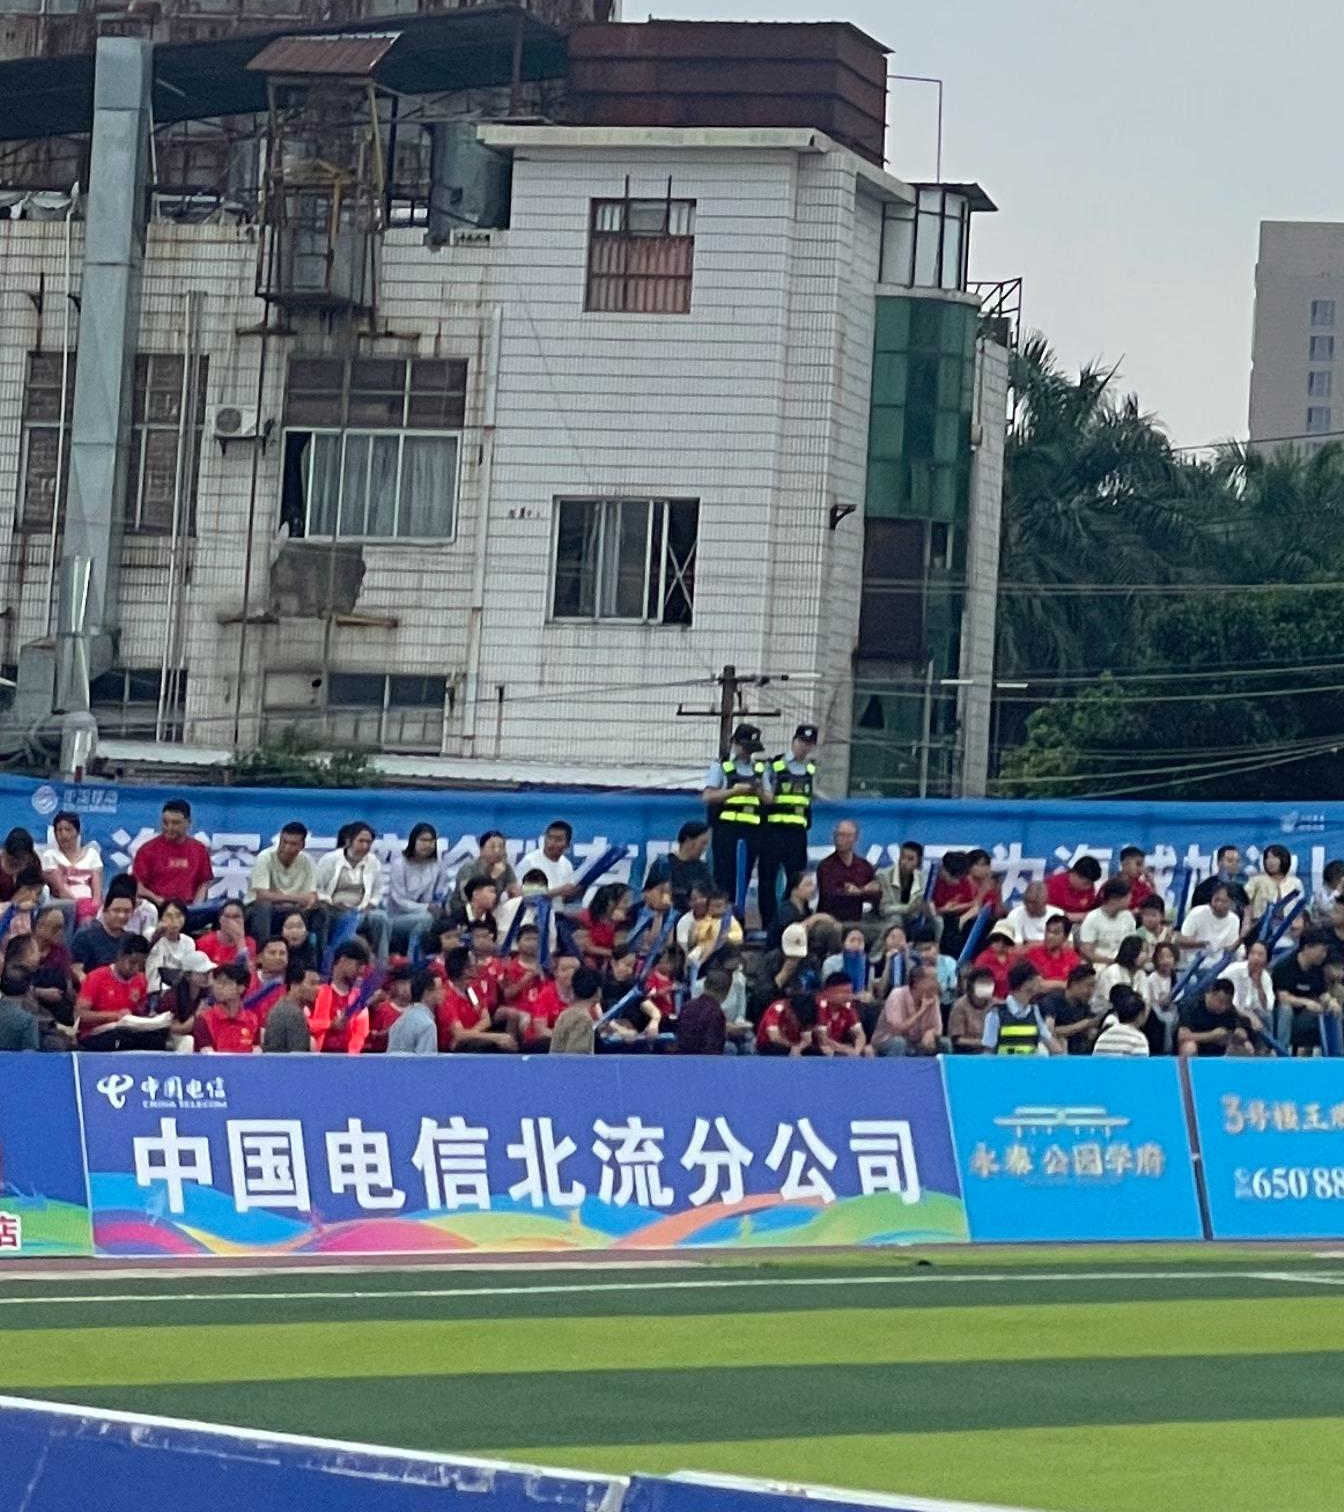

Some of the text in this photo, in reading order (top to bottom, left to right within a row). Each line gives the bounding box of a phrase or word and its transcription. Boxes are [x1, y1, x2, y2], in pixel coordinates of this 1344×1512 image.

[133, 1117, 922, 1213] 中国电信北流分公司
